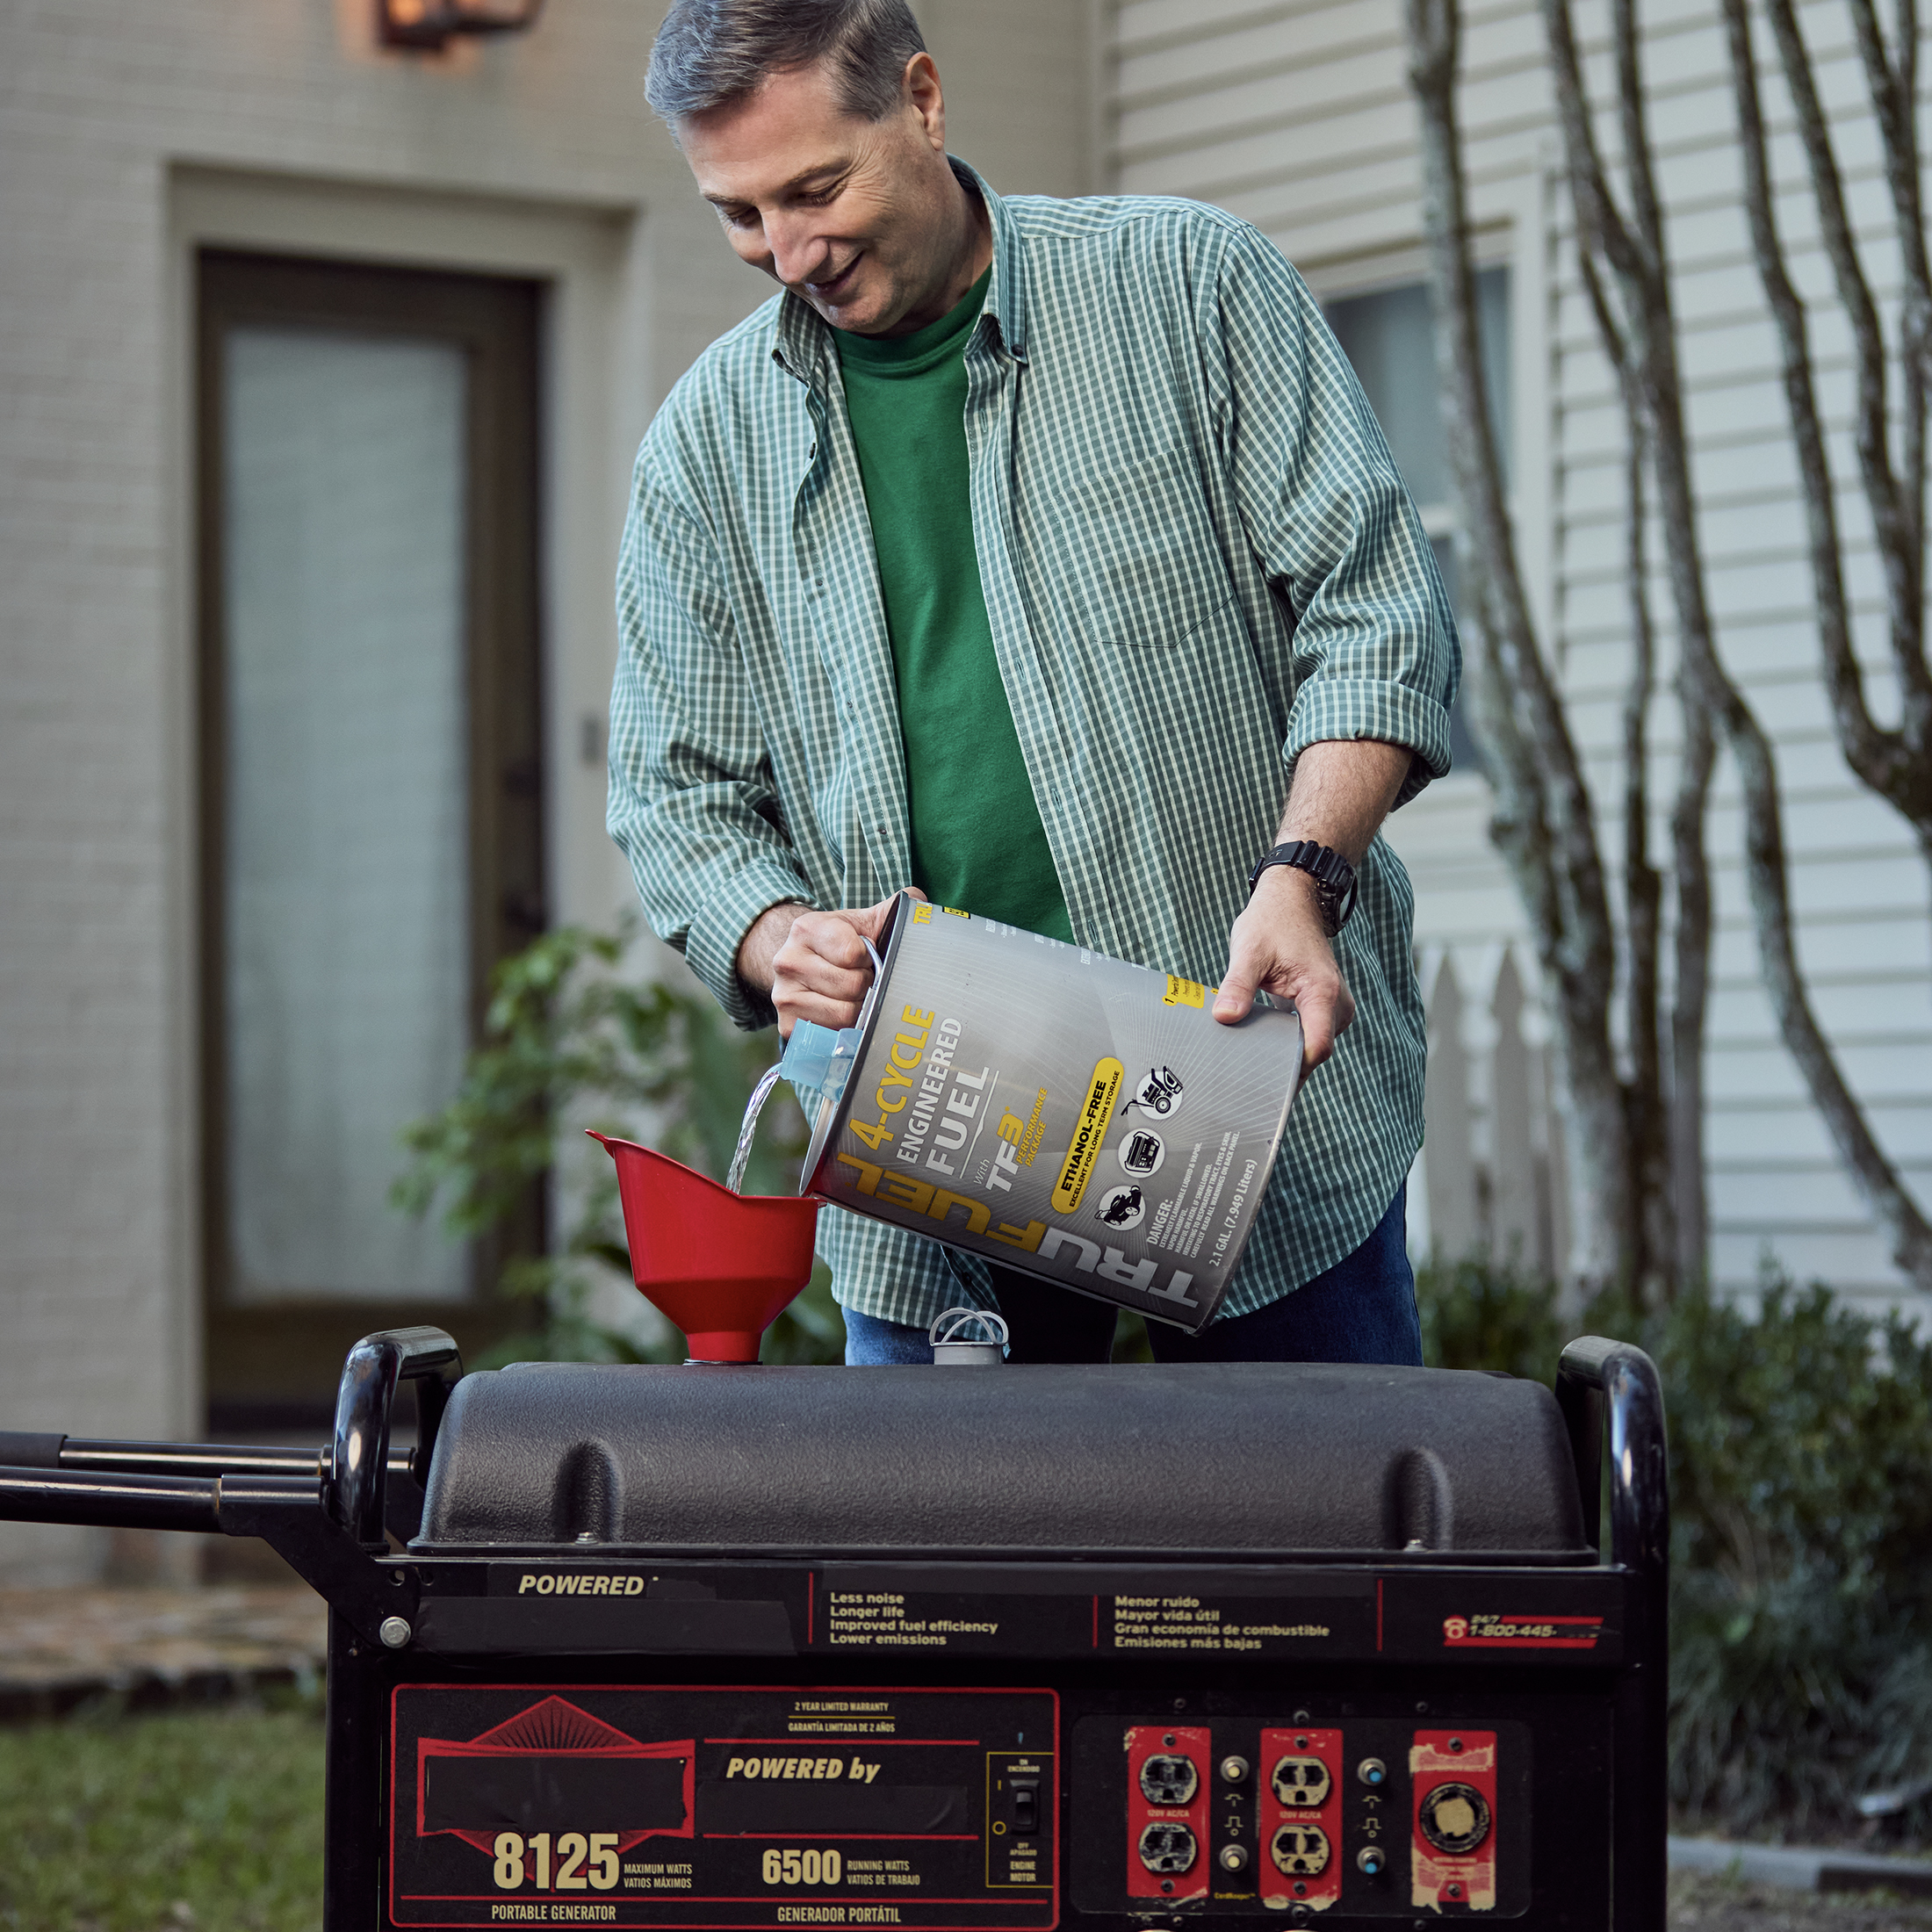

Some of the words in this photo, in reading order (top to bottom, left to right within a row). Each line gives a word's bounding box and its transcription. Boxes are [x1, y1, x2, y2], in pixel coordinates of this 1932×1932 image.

[848, 1005, 935, 1150] 4-CYCLE
[897, 1018, 962, 1164] ENGINEERED
[925, 1066, 990, 1175] FUEL
[1016, 1086, 1048, 1164] PERFORMANCE
[1025, 1121, 1046, 1167] PACKAGE
[1061, 1080, 1107, 1191] ETHANOL-FREE
[1070, 1167, 1088, 1207] EXCELLENT
[1085, 1152, 1093, 1167] FOR
[1092, 1129, 1101, 1150] LONG
[1098, 1107, 1108, 1128] TERM
[1105, 1071, 1120, 1106] STORAGE
[1230, 1131, 1240, 1150] PANEL.
[1225, 1151, 1234, 1166] BACK
[974, 1158, 991, 1185] With
[1222, 1166, 1229, 1175] ON
[1236, 1159, 1258, 1193] Liters)
[1195, 1163, 1213, 1200] SWALLOWED.
[1159, 1221, 1174, 1248] EXTREMELY
[1171, 1188, 1186, 1221] FLAMMABLE
[1182, 1168, 1193, 1188] LIQUID
[1192, 1143, 1202, 1163] VAPOR.
[1211, 1175, 1226, 1206] WARNINGS
[1183, 1229, 1197, 1256] IRRITATING
[1196, 1186, 1213, 1221] RESPIRATORY
[1209, 1165, 1221, 1185] TRACT,
[1187, 1206, 1197, 1222] FATAL
[1224, 1194, 1244, 1229] (7.949
[1147, 1200, 1173, 1244] DANGER:
[1167, 1234, 1178, 1251] VAPOR
[1174, 1207, 1188, 1234] HARMFUL.
[1185, 1221, 1192, 1229] OR
[1201, 1216, 1211, 1230] READ
[1175, 1229, 1188, 1253] HARMFUL
[1191, 1232, 1205, 1258] CAREFULLY
[1215, 1231, 1232, 1251] GAL.
[1209, 1251, 1223, 1266] 2.1
[518, 1575, 644, 1595] POWERED
[831, 1592, 863, 1604] Less
[867, 1593, 905, 1604] noise
[1115, 1596, 1160, 1607] Menor
[1163, 1597, 1200, 1607] ruido
[830, 1605, 879, 1618] Longer
[883, 1606, 905, 1618] life
[1115, 1609, 1159, 1622] Mayor
[1163, 1610, 1193, 1621] vida
[1195, 1610, 1220, 1622] útil
[830, 1619, 896, 1632] Improved
[899, 1620, 926, 1632] fuel
[929, 1620, 998, 1634] efficiency
[1114, 1623, 1149, 1633] Gran
[1152, 1625, 1220, 1634] economía
[1222, 1625, 1240, 1635] de
[1243, 1625, 1330, 1636] combustible
[1468, 1625, 1601, 1637] 1-800-445-
[830, 1633, 873, 1643] Lower
[876, 1633, 947, 1645] emissions
[1114, 1636, 1187, 1648] Emisiones
[1191, 1637, 1221, 1648] más
[1224, 1638, 1262, 1651] bajas
[795, 1702, 800, 1711] 2
[802, 1702, 820, 1711] YEAR
[821, 1702, 848, 1711] LIMITED
[850, 1702, 889, 1711] WARRANTY
[789, 1721, 824, 1732] GARANTÍA
[825, 1723, 857, 1732] LIMITADA
[859, 1723, 868, 1732] DE
[870, 1723, 875, 1732] 2
[876, 1721, 895, 1732] AÑOS
[726, 1758, 843, 1778] POWERED
[848, 1756, 881, 1784] by
[494, 1832, 619, 1889] 8125
[624, 1864, 664, 1874] MAXIMUM
[667, 1864, 692, 1874] WATTS
[762, 1849, 841, 1885] 6500
[847, 1860, 883, 1871] RUNNING
[885, 1860, 910, 1871] WATTS
[1010, 1861, 1036, 1870] ENGINE
[624, 1878, 651, 1888] VATIOS
[654, 1877, 692, 1888] MÁXIMOS
[847, 1875, 873, 1885] VATIOS
[876, 1875, 885, 1885] DE
[888, 1875, 920, 1885] TRABAJO
[492, 1905, 547, 1920] PORTABLE
[551, 1906, 616, 1920] GENERATOR
[778, 1907, 845, 1921] GENERADOR
[849, 1906, 901, 1922] PORTÁTIL
